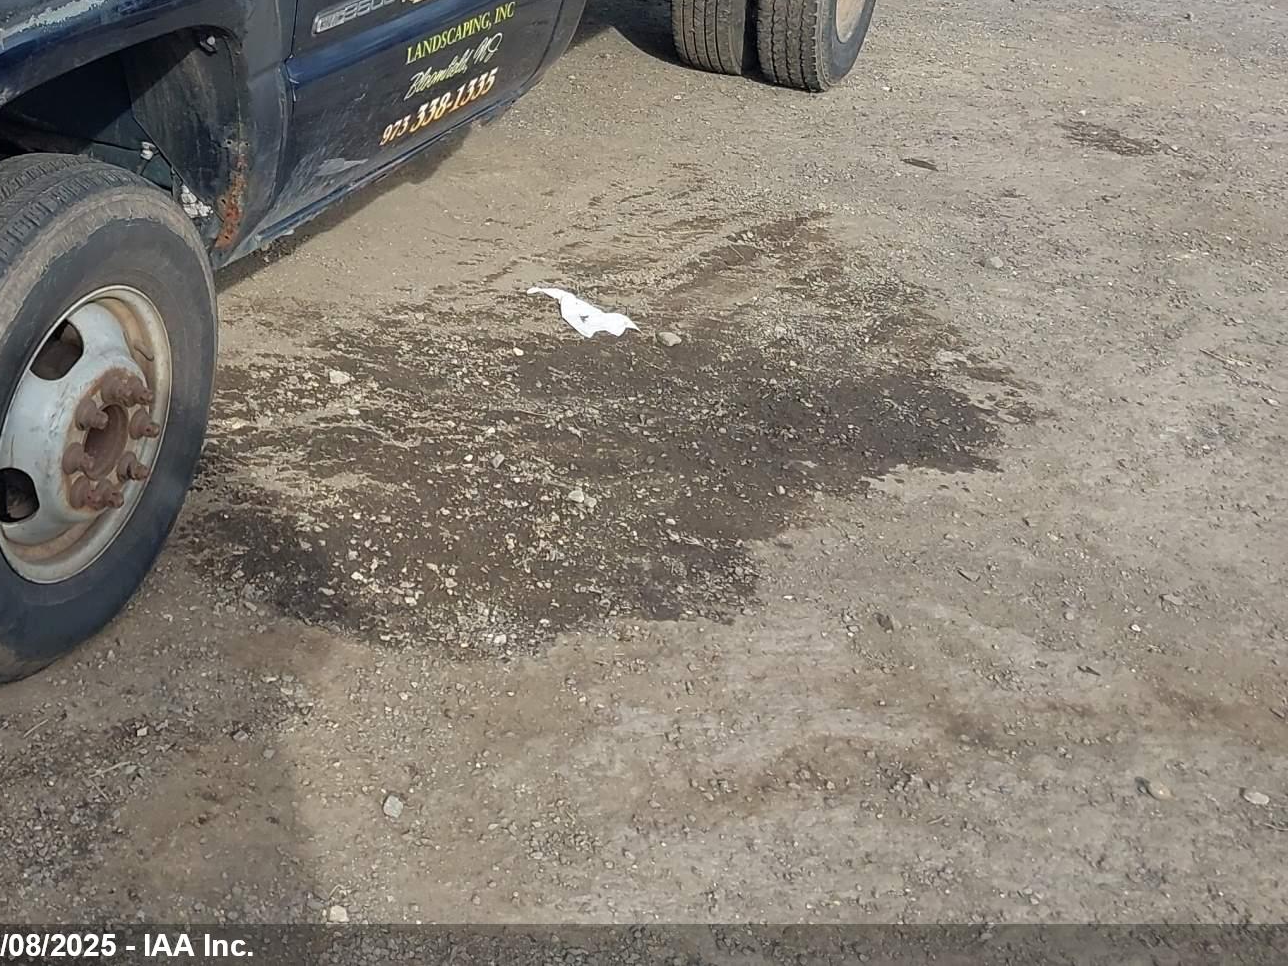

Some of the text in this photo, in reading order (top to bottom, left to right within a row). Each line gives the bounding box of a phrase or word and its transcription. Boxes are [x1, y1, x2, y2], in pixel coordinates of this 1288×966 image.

[405, 1, 516, 65] LANDSCAPING, INC
[379, 66, 499, 147] 973 338-1335
